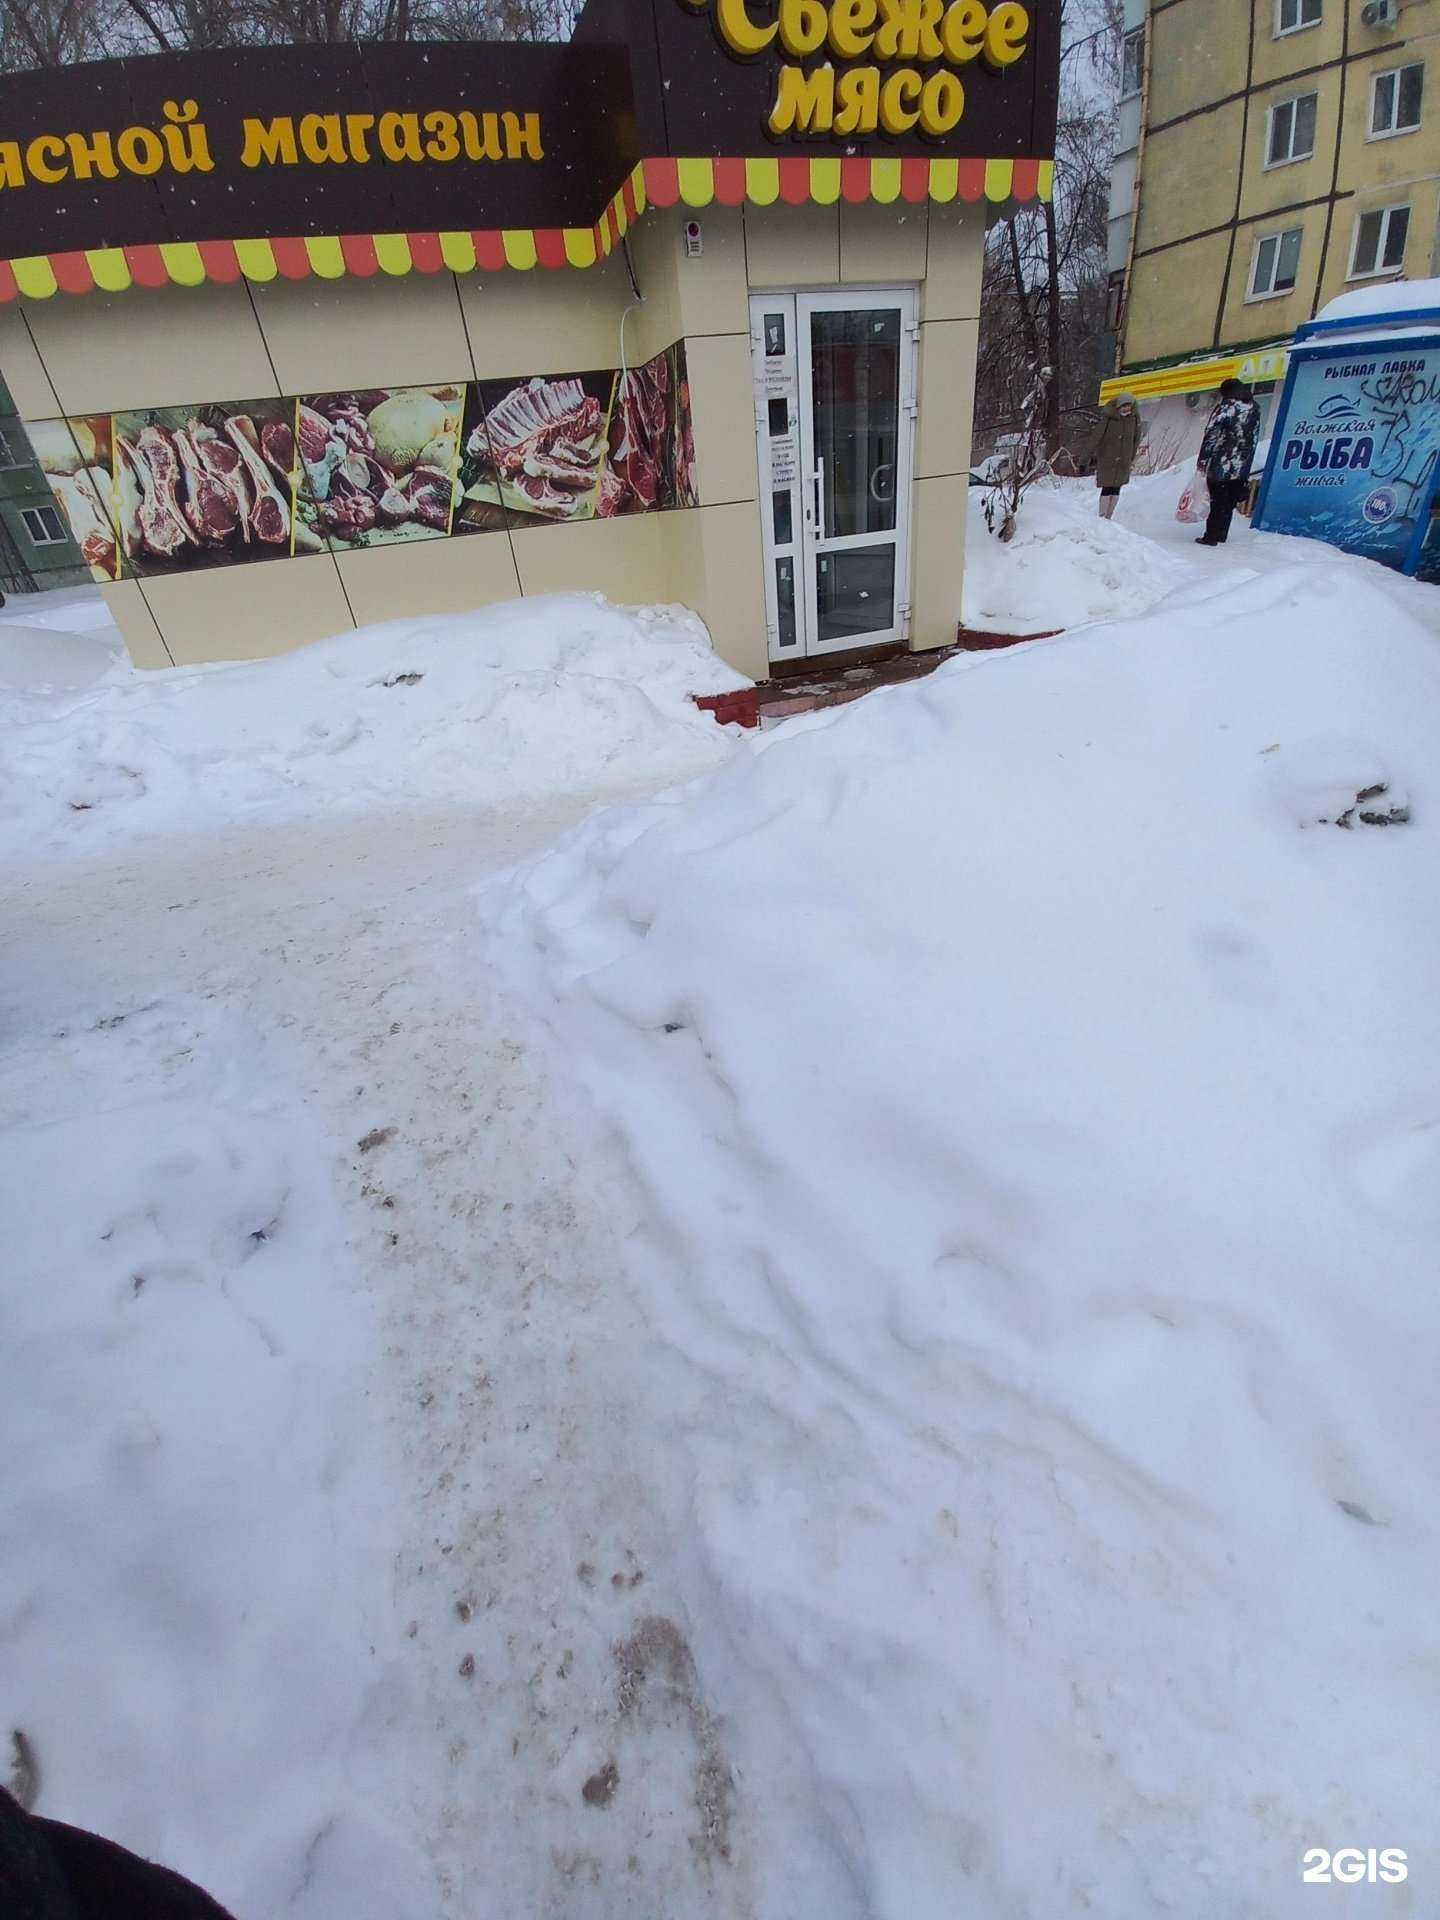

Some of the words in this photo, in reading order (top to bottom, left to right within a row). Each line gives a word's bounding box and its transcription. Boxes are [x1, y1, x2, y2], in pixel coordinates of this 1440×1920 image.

[240, 110, 545, 168] магазин
[1324, 362, 1377, 379] РЫБНАЯ
[1380, 359, 1426, 375] ЛАВКА
[1294, 419, 1376, 436] Волжская
[1282, 437, 1374, 470] РЫБА
[1295, 473, 1346, 487] живая
